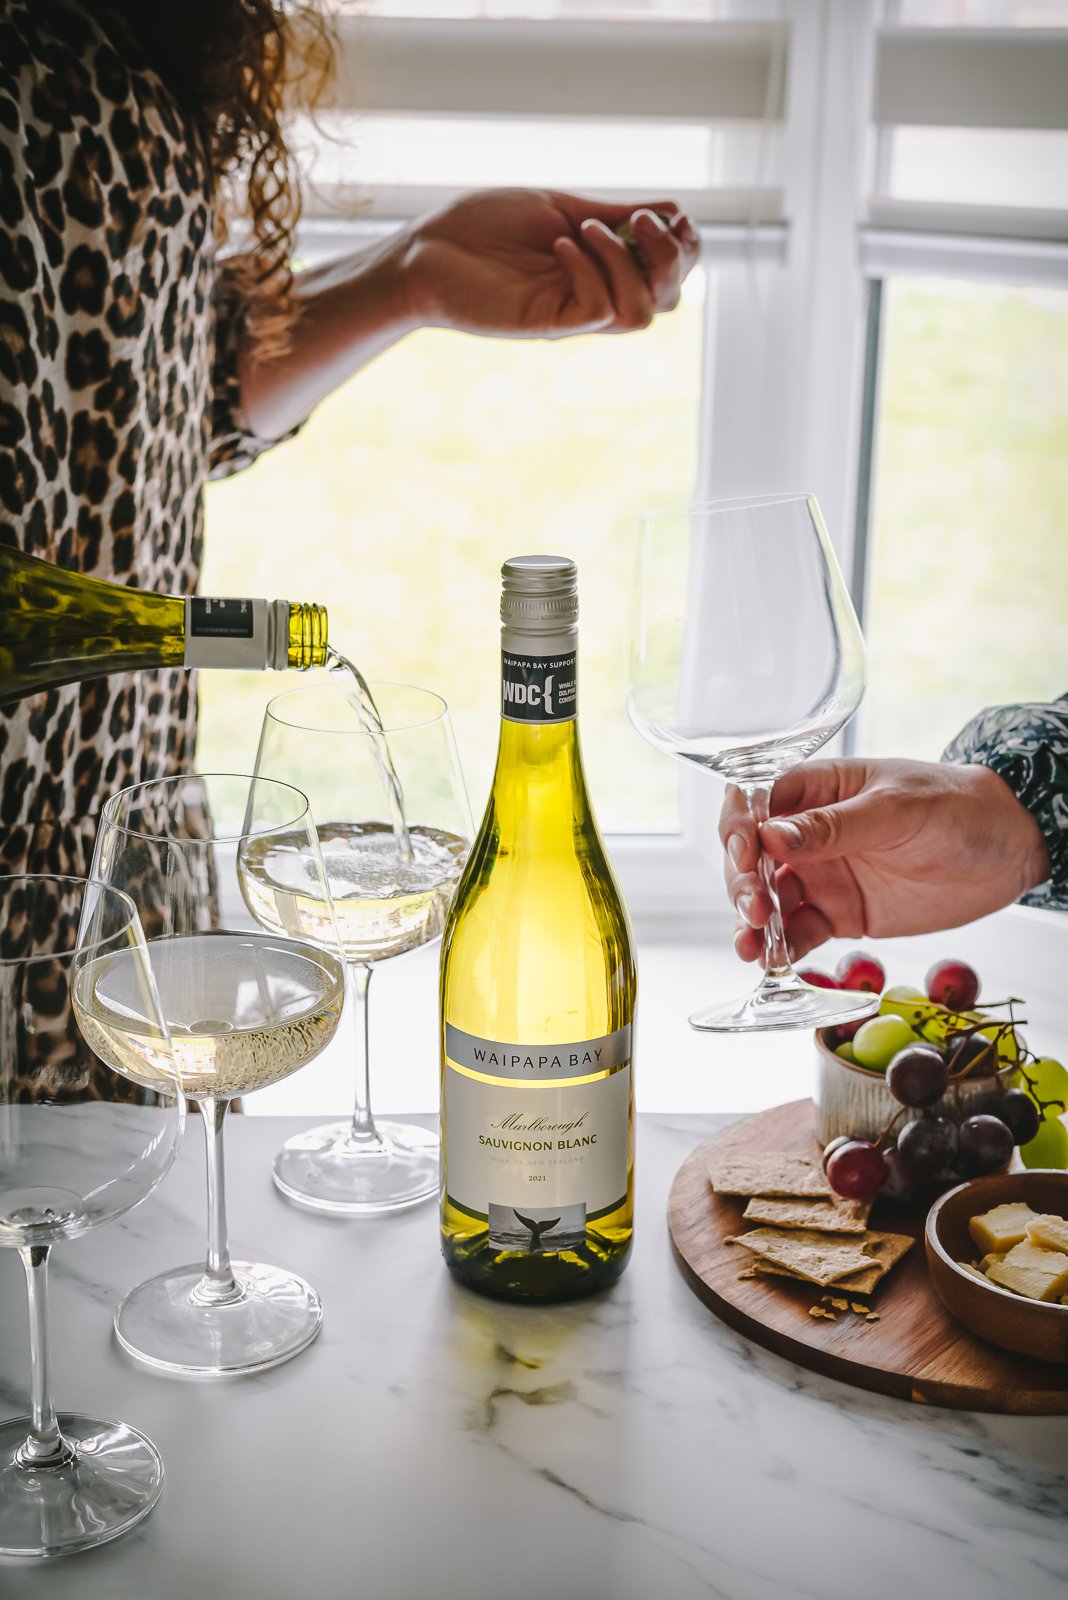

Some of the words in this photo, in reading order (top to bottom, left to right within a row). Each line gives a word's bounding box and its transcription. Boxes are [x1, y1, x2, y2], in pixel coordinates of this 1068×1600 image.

[503, 680, 541, 706] WDC
[473, 1048, 562, 1069] WAIPAPA
[569, 1048, 603, 1067] BAY
[490, 1111, 589, 1136] Marlborough
[478, 1134, 553, 1152] SAUVIGNON
[557, 1134, 597, 1150] BLANC
